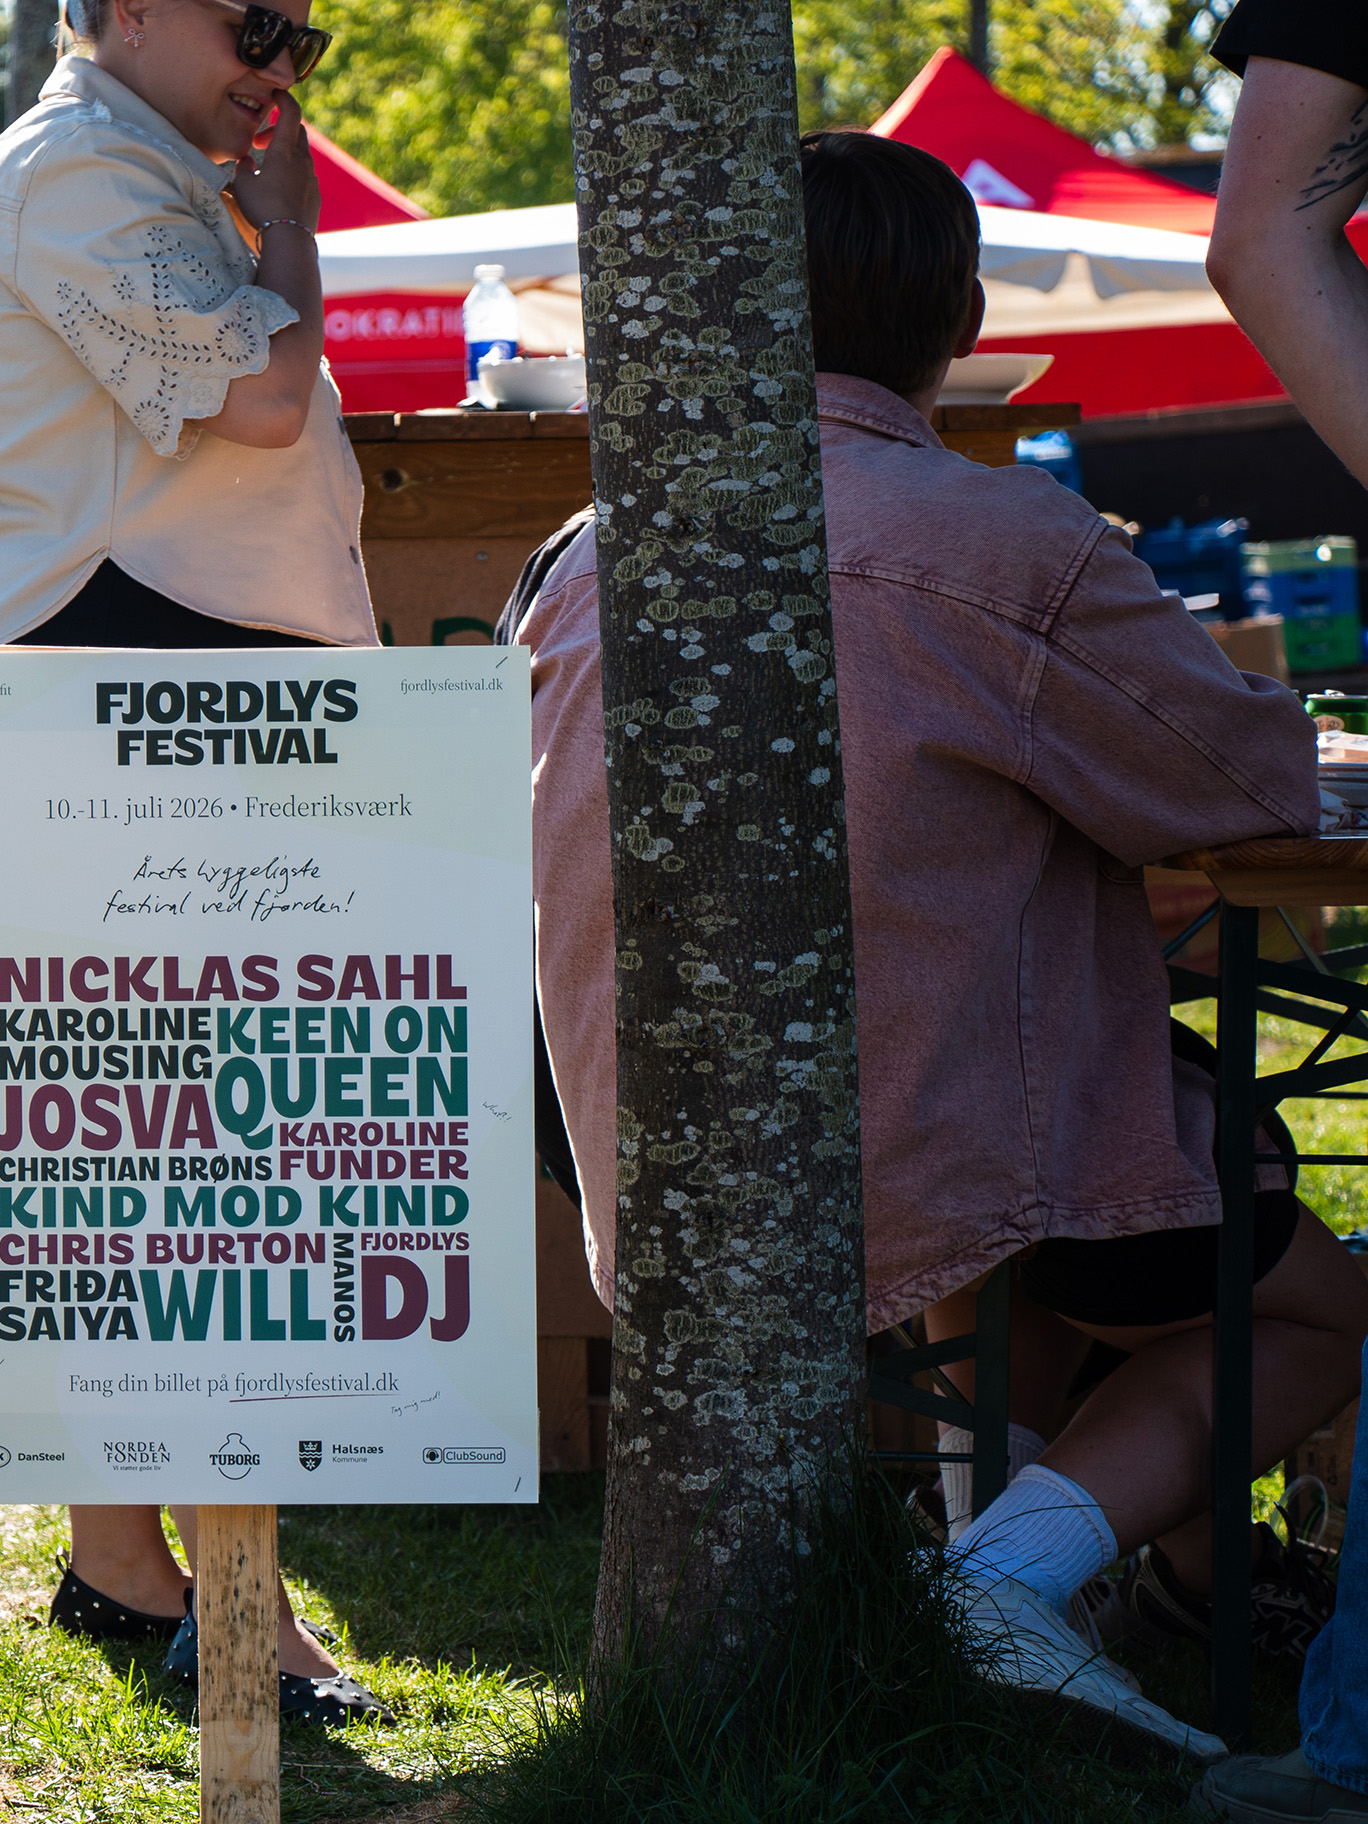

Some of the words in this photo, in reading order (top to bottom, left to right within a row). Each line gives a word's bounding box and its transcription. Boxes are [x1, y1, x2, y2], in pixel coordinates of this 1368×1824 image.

[96, 679, 358, 725] FJORDLYS
[400, 677, 503, 696] fjordlysfestival.dk
[117, 728, 338, 766] FESTIVAL
[45, 799, 118, 820] 10.-11.
[124, 796, 163, 825] juli
[170, 797, 223, 819] 2026
[245, 794, 413, 819] Frederiksværk
[133, 855, 187, 881] Årets
[196, 855, 322, 899] hyggeligste
[103, 889, 192, 922] festival
[201, 889, 248, 914] ved
[250, 888, 356, 922] fjorden!
[296, 954, 468, 1001] SAHL
[216, 1006, 371, 1055] KEEN
[384, 1005, 468, 1054] ON
[214, 1056, 469, 1151] QUEEN
[279, 1121, 469, 1147] KAROLINE
[168, 1155, 273, 1184] BRØNS
[279, 1150, 469, 1181] FUNDER
[163, 1185, 303, 1228] MOD
[319, 1184, 470, 1227] KIND
[145, 1232, 326, 1265] BURTON
[360, 1232, 470, 1252] FJORDLYS
[333, 1232, 356, 1343] MANOS
[361, 1255, 471, 1342] DJ
[138, 1269, 327, 1342] WILL
[69, 1374, 114, 1397] Fang
[118, 1373, 149, 1392] din
[154, 1372, 202, 1392] billet
[207, 1373, 230, 1397] på
[234, 1372, 400, 1395] fjordlysfestival.dk
[17, 1452, 65, 1462] DanSteel
[103, 1441, 167, 1452] NORDEA
[107, 1452, 171, 1463] FONDEN
[209, 1454, 261, 1466] TUBORG
[332, 1444, 384, 1455] Halsnæs
[445, 1451, 503, 1462] ClubSound
